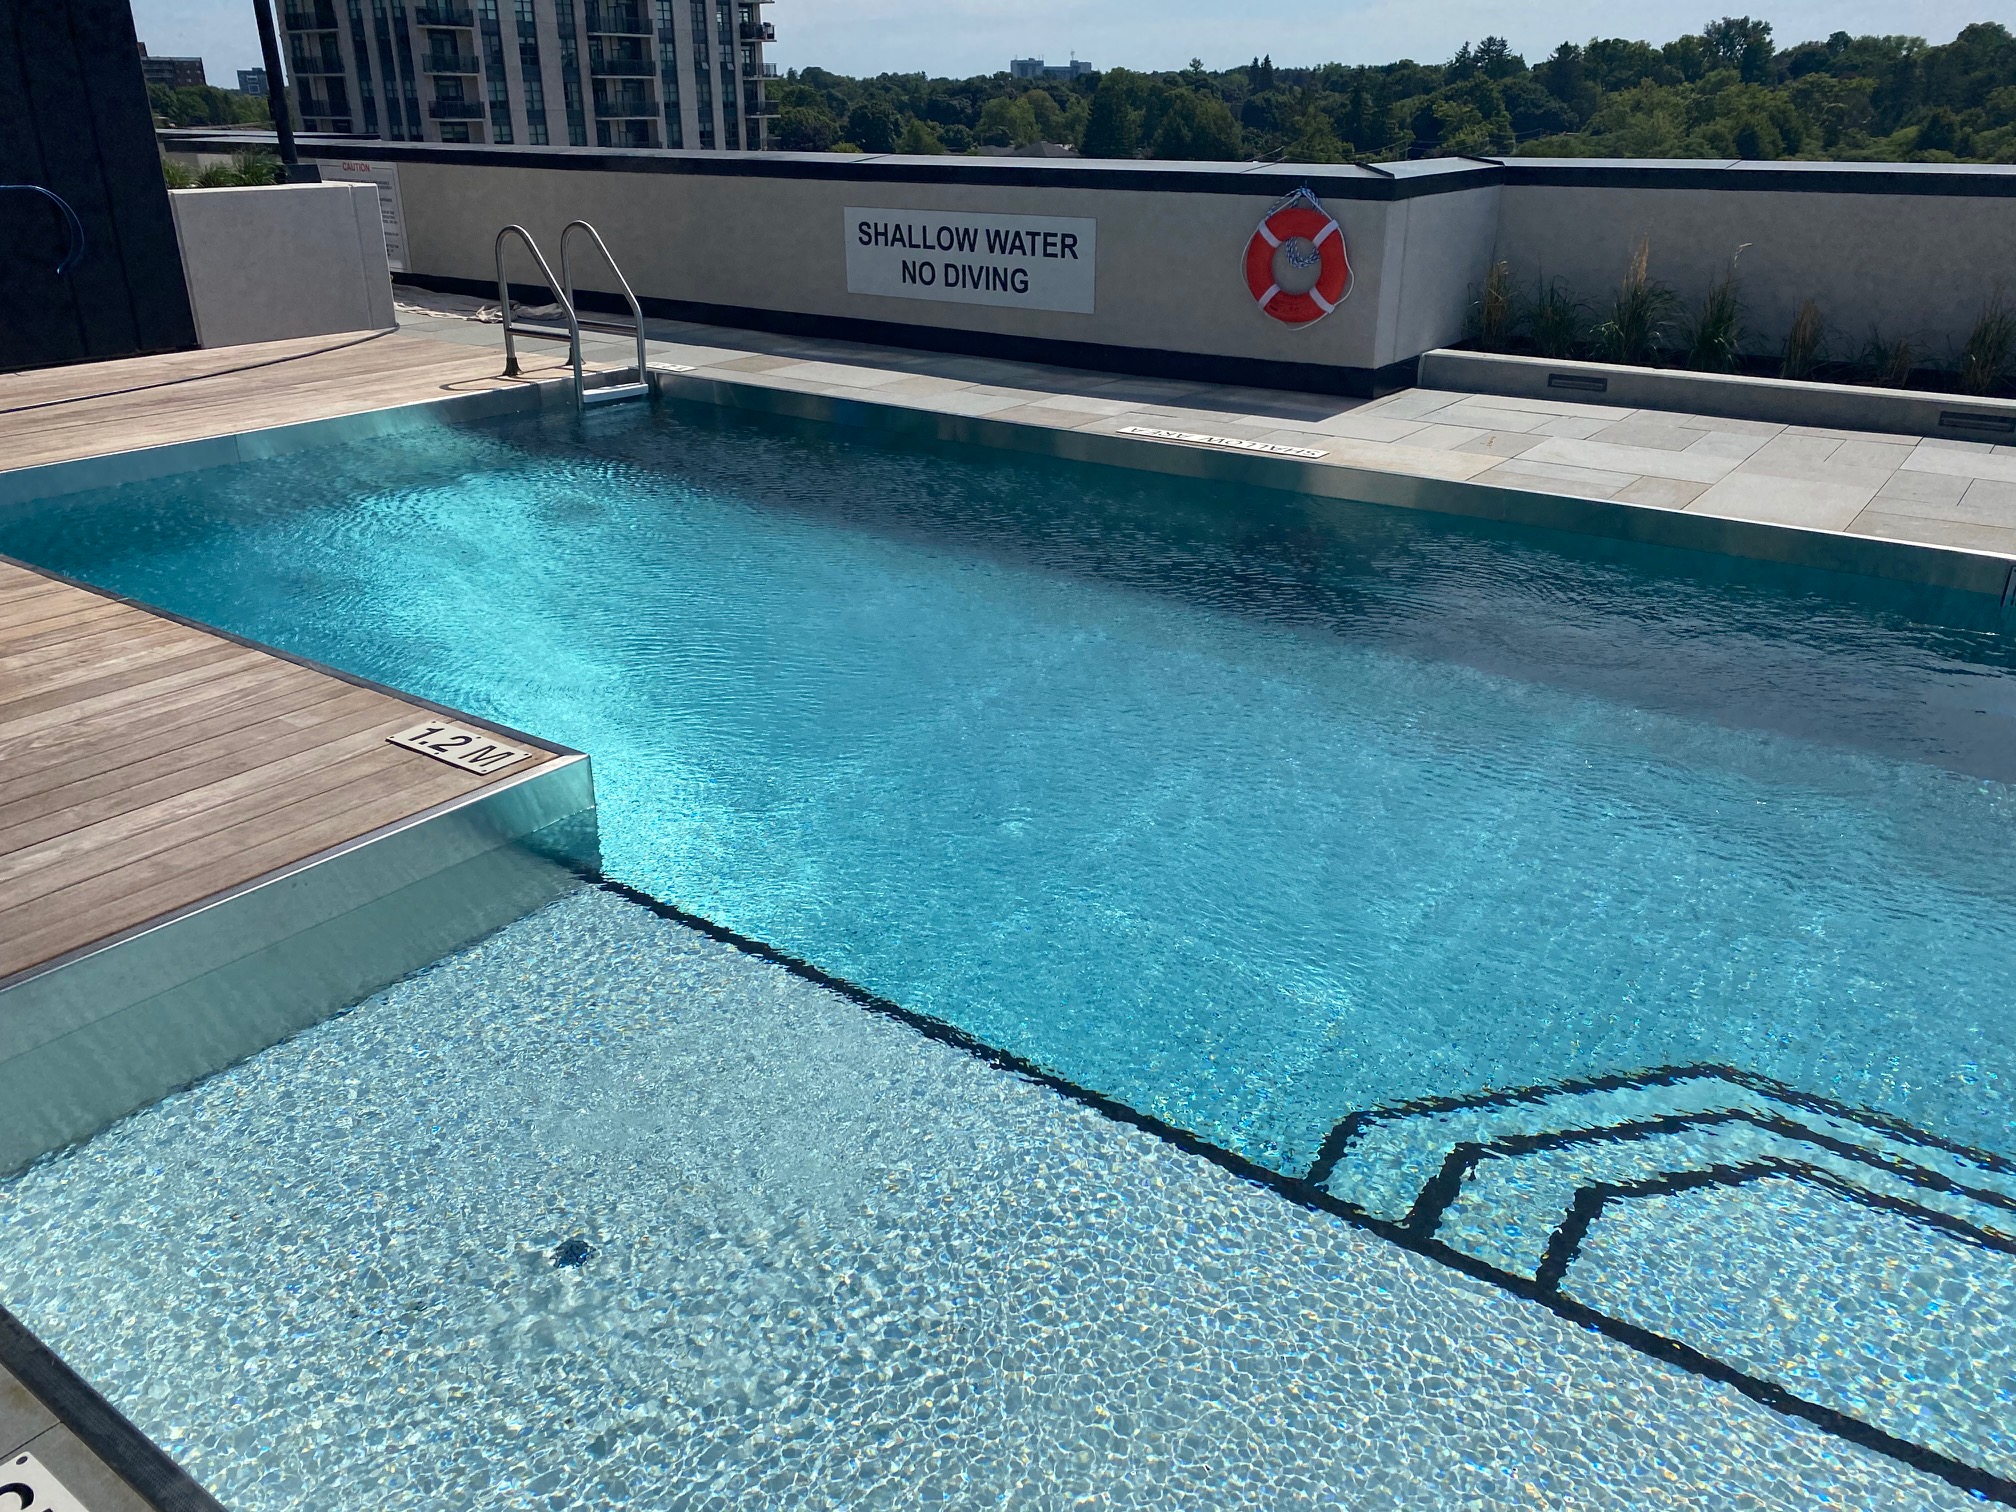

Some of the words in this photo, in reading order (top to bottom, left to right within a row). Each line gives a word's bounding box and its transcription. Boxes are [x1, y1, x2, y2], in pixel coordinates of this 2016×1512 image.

[342, 162, 370, 172] CAUTION
[858, 221, 978, 253] SHALLOW
[985, 228, 1079, 259] WATER
[902, 260, 936, 286] NO
[944, 263, 1029, 294] DIVING
[1131, 427, 1193, 438] AREA
[1200, 437, 1319, 456] SHALLOW
[408, 727, 473, 753] 1.2
[458, 744, 515, 767] M
